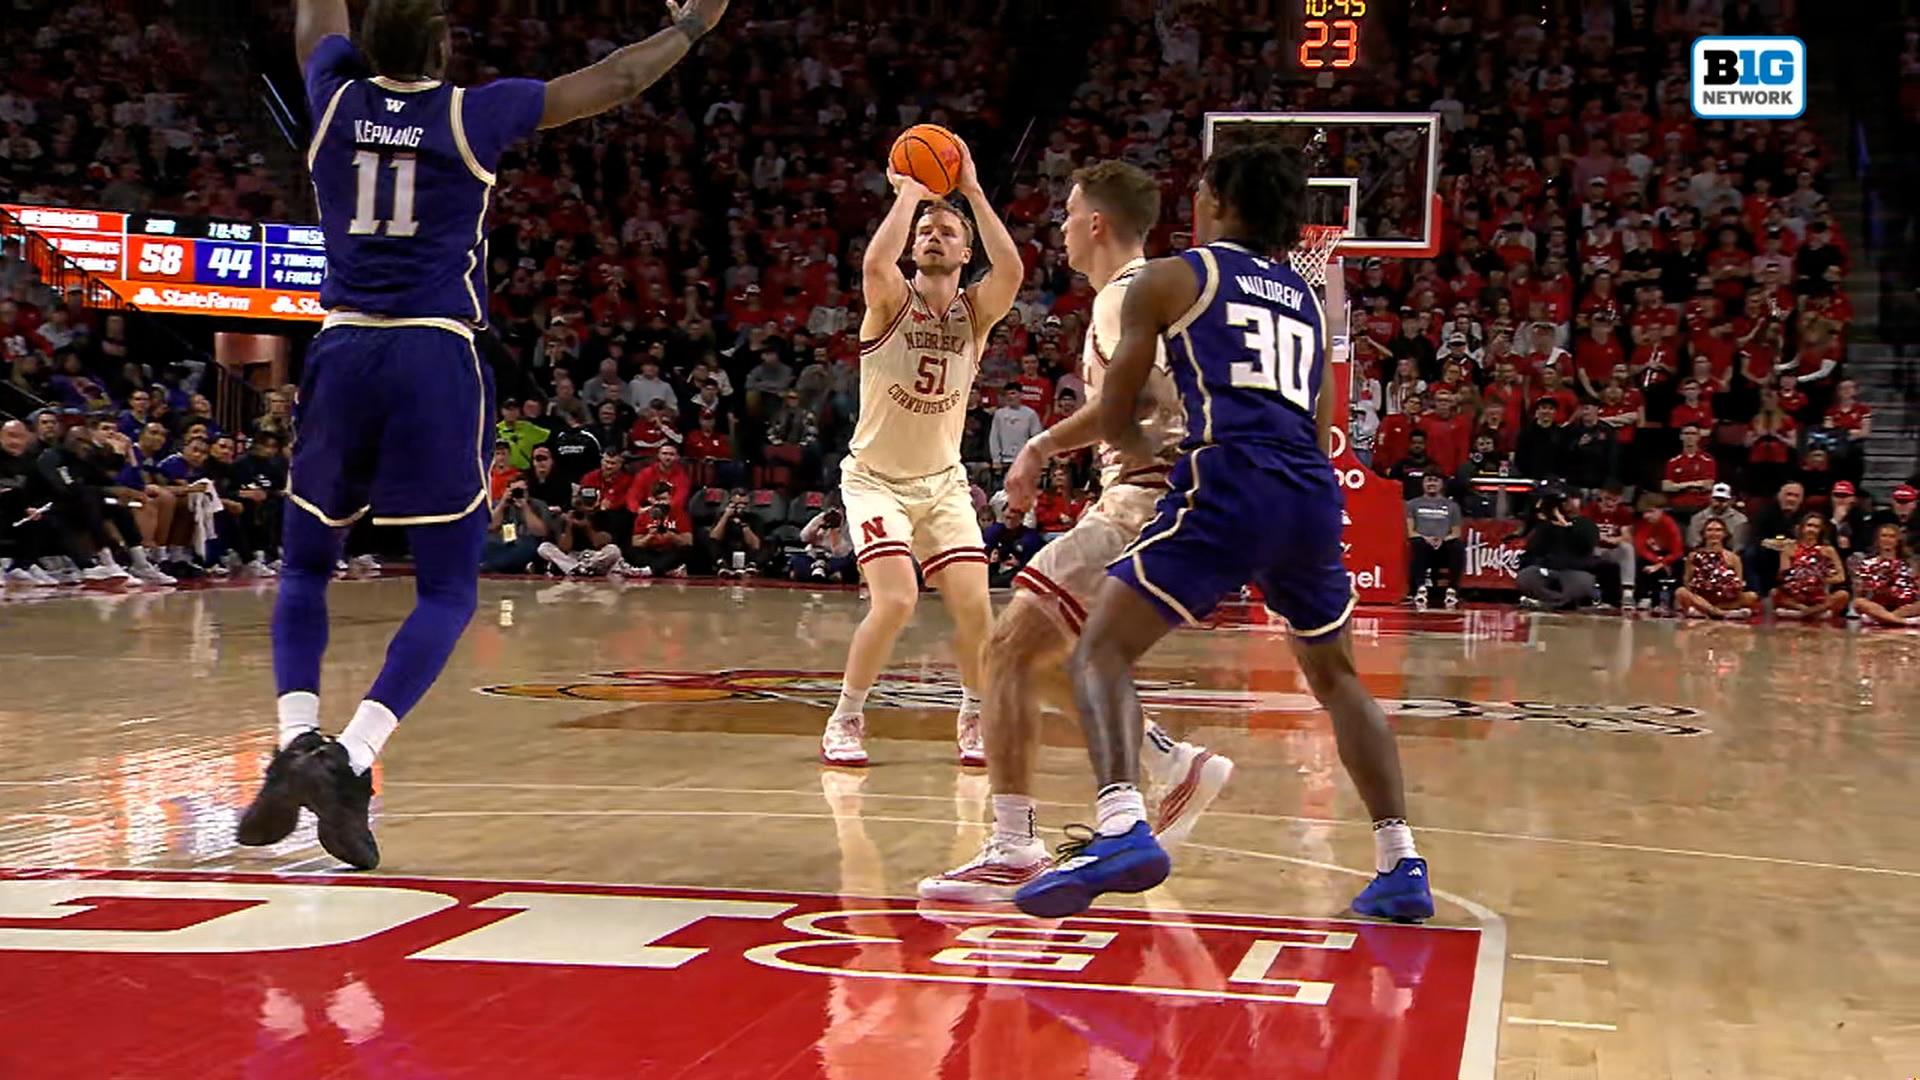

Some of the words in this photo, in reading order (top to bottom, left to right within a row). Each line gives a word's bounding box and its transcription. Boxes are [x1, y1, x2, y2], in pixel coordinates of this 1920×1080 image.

[1301, 20, 1357, 67] 23
[385, 98, 406, 113] W
[354, 119, 423, 147] KEPNANG
[347, 152, 419, 237] 11
[138, 243, 184, 275] 58
[208, 247, 253, 279] 44
[271, 253, 281, 265] 3
[273, 270, 283, 282] 4
[1226, 302, 1315, 412] 30
[914, 355, 948, 395] 51
[861, 516, 887, 544] N
